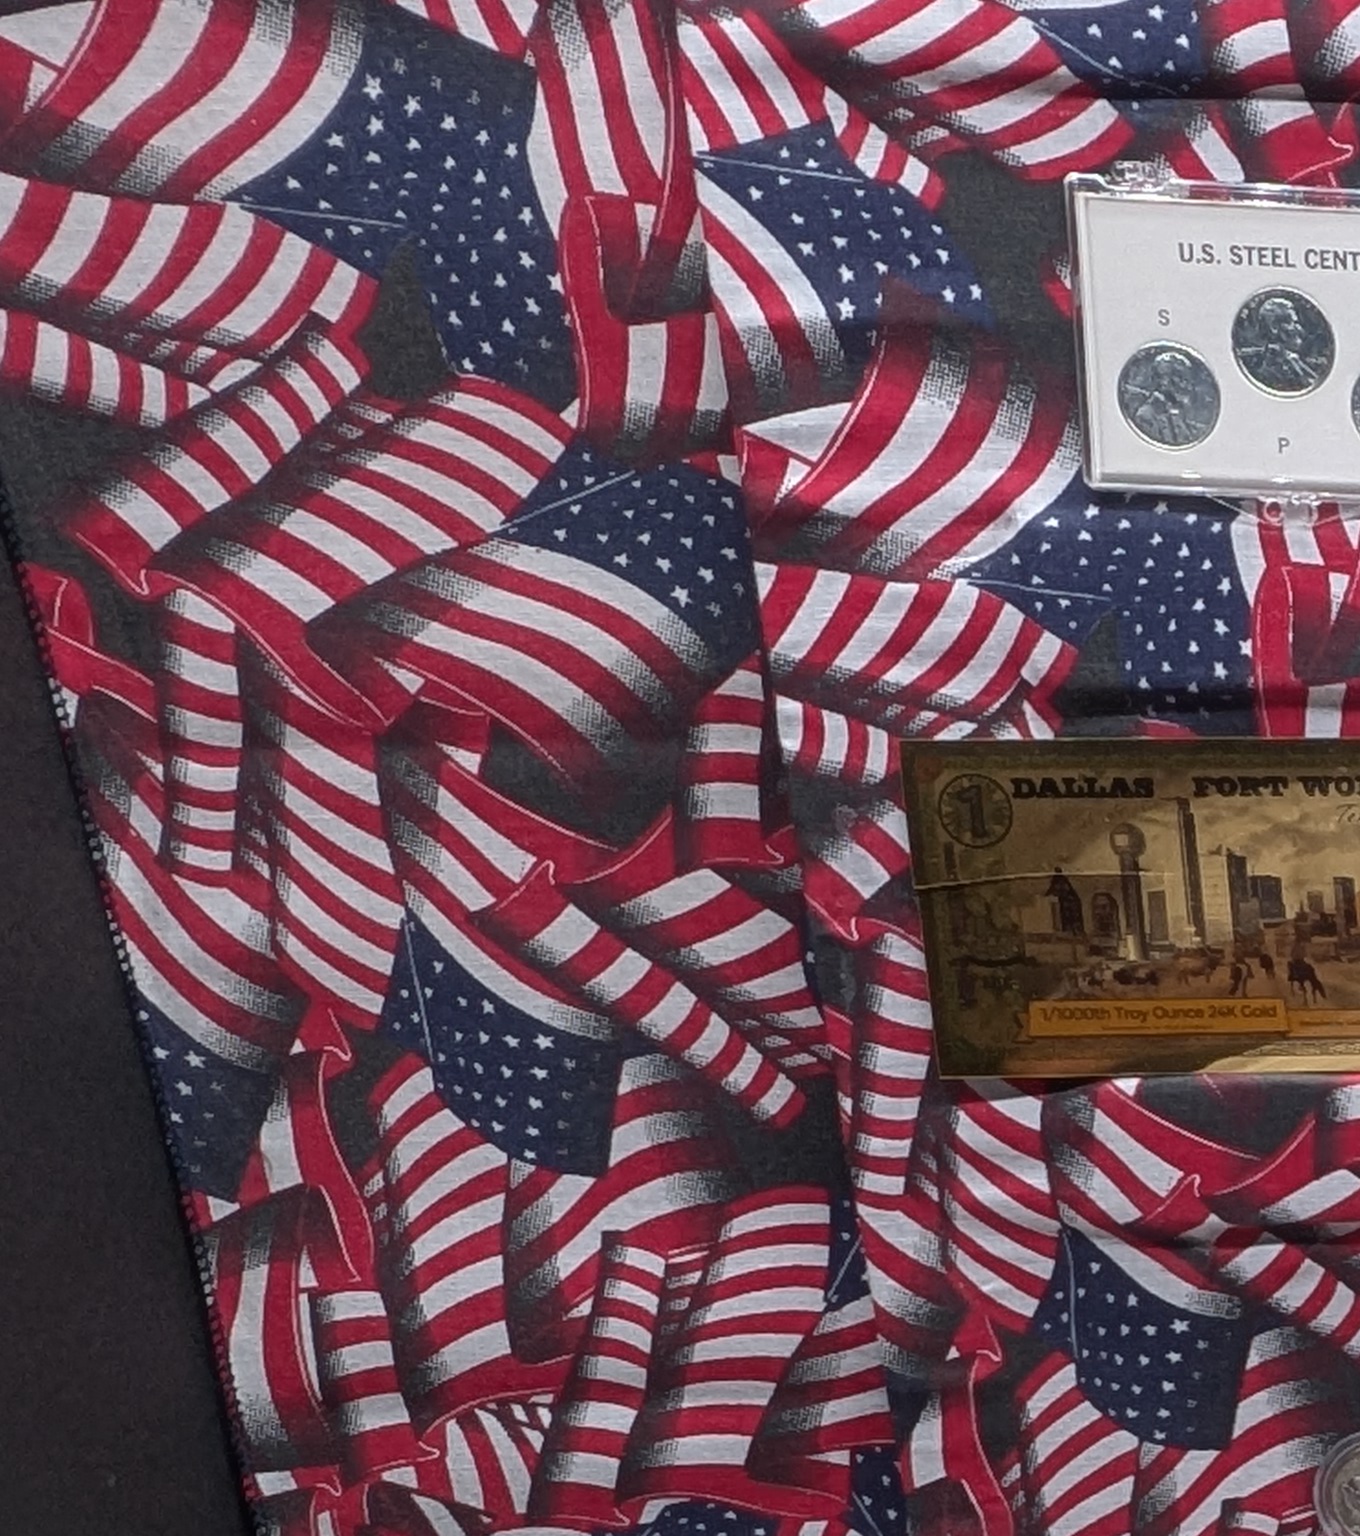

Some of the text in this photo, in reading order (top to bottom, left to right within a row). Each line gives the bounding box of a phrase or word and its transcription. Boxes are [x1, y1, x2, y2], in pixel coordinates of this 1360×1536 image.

[1178, 242, 1221, 265] U.S.
[1229, 245, 1296, 268] STEEL
[1158, 309, 1171, 327] S
[1278, 437, 1290, 454] P
[1010, 775, 1155, 799] DALLAS
[1190, 774, 1289, 799] FORT
[1115, 1006, 1149, 1024] Troy
[1152, 1005, 1206, 1022] Ounce
[1241, 1003, 1278, 1020] Gold
